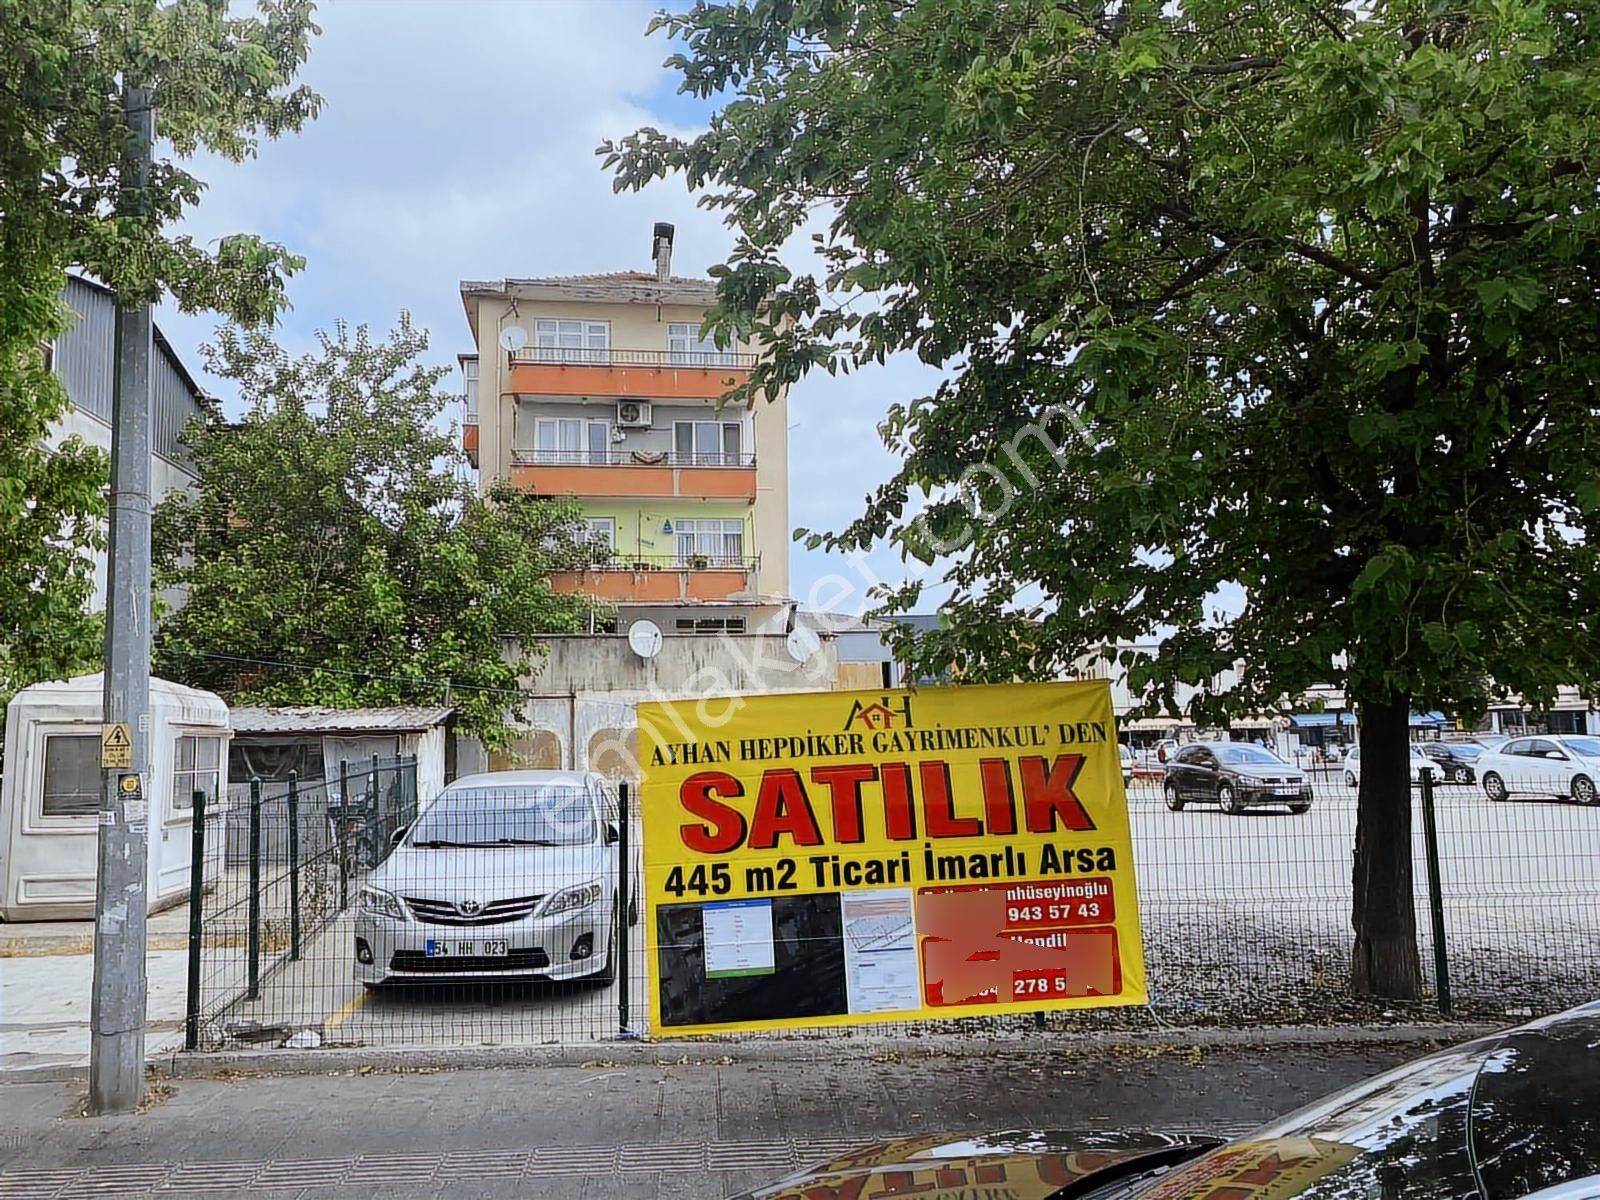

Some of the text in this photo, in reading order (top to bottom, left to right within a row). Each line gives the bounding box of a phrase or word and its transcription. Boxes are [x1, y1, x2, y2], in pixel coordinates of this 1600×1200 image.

[650, 740, 731, 766] AYHAN
[740, 730, 865, 761] HEPDİKER
[1059, 721, 1108, 745] DEN
[680, 753, 1097, 854] SATILIK
[664, 842, 1116, 897] 445 m2 Ticari İmarlı Arsa
[1004, 881, 1109, 903] nhüseyinoğlu
[1008, 903, 1100, 922] 943 57 43
[1014, 979, 1049, 995] 278
[1054, 977, 1067, 992] 5
